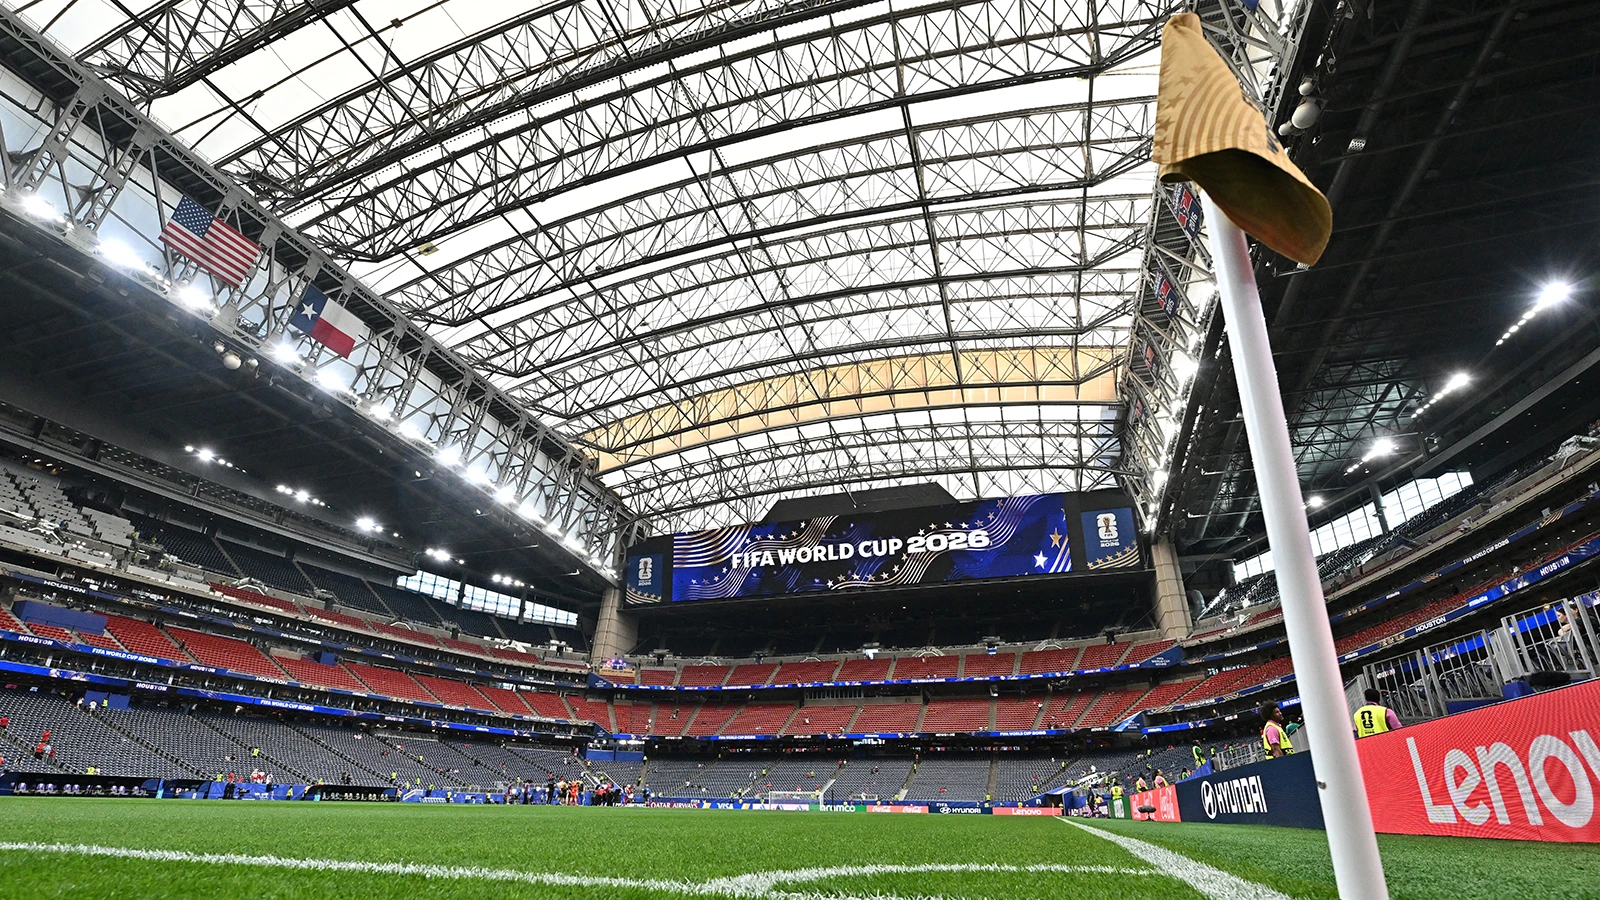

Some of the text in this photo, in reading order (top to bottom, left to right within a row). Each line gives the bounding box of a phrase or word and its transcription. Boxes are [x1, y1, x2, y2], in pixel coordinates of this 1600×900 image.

[731, 530, 990, 569] FIFA WORLD CUP 2026
[1540, 556, 1570, 576] HOUSTON
[43, 580, 86, 594] HOUSTON
[1415, 616, 1446, 633] HOUSTON
[18, 635, 54, 646] HOUSTON
[106, 650, 126, 658] WORLD
[136, 682, 168, 692] HOUSTON
[256, 676, 288, 686] HOUSTON
[1406, 729, 1600, 828] Leno
[1214, 775, 1268, 814] HYUNDAI
